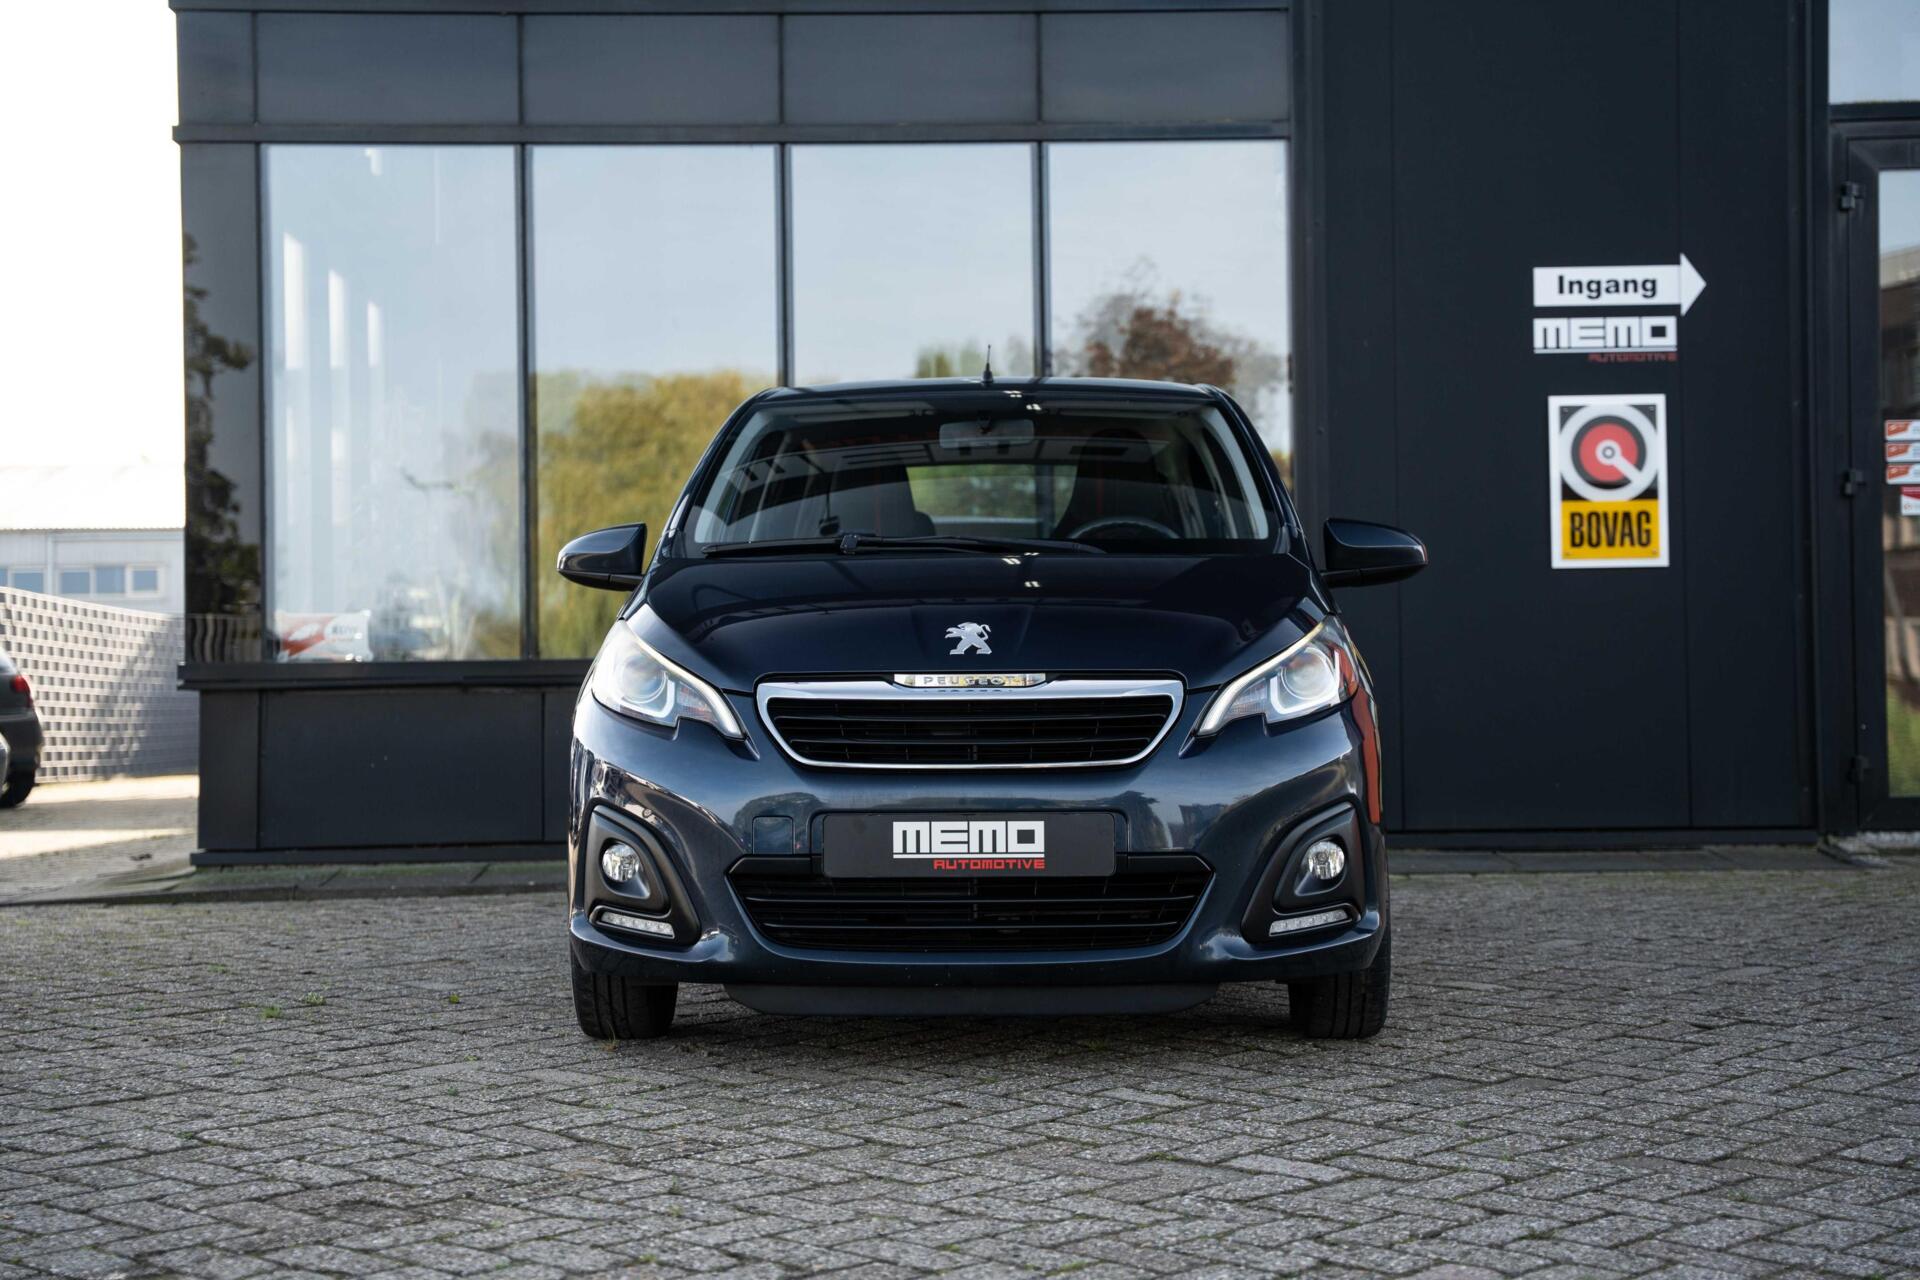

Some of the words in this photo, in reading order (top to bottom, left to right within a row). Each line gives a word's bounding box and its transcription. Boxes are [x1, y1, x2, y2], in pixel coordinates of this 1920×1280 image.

[1557, 275, 1657, 299] Ingang
[1533, 316, 1677, 349] MEMO
[1569, 511, 1651, 548] BOVAG
[923, 676, 1015, 685] PEUGEOT
[893, 821, 1045, 853] MEMO
[933, 859, 1045, 870] AUTOMOTIVE
